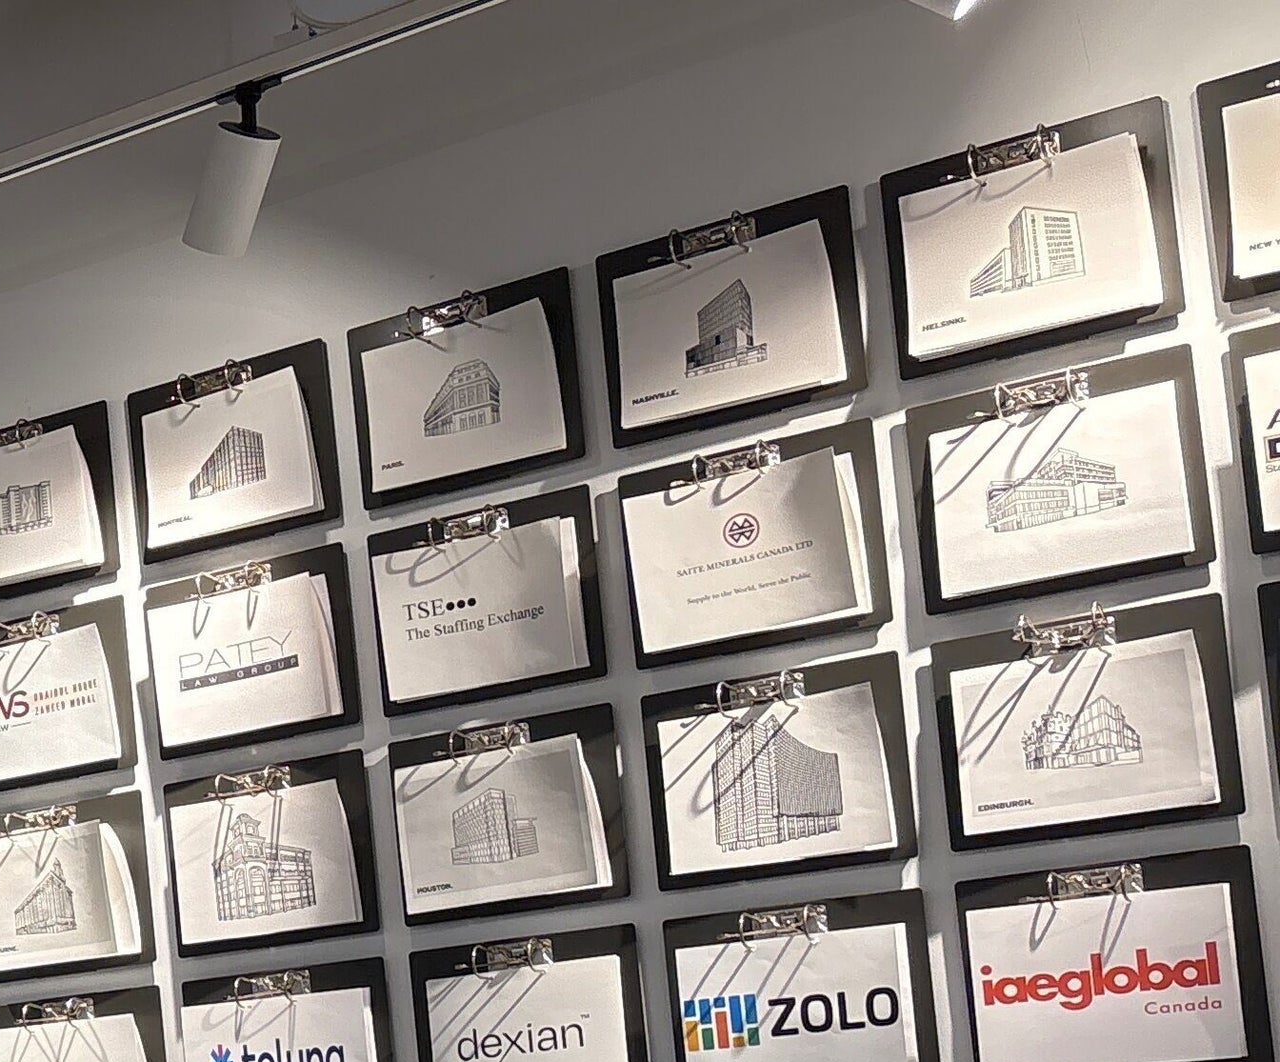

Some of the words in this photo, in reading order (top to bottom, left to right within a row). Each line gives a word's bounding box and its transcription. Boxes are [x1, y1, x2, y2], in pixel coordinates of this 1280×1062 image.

[676, 565, 705, 577] SAITE
[706, 553, 755, 572] MINERALS
[756, 545, 794, 560] CANADA
[795, 539, 814, 551] LTD
[406, 627, 430, 642] The
[433, 618, 485, 638] Staffing
[487, 604, 545, 627] Exchange
[179, 631, 292, 678] PATEY
[181, 675, 218, 690] LAW
[236, 657, 299, 680] GROUP
[981, 941, 1221, 1011] iaeglobal
[768, 986, 900, 1038] ZOLO
[1144, 996, 1223, 1016] Canada
